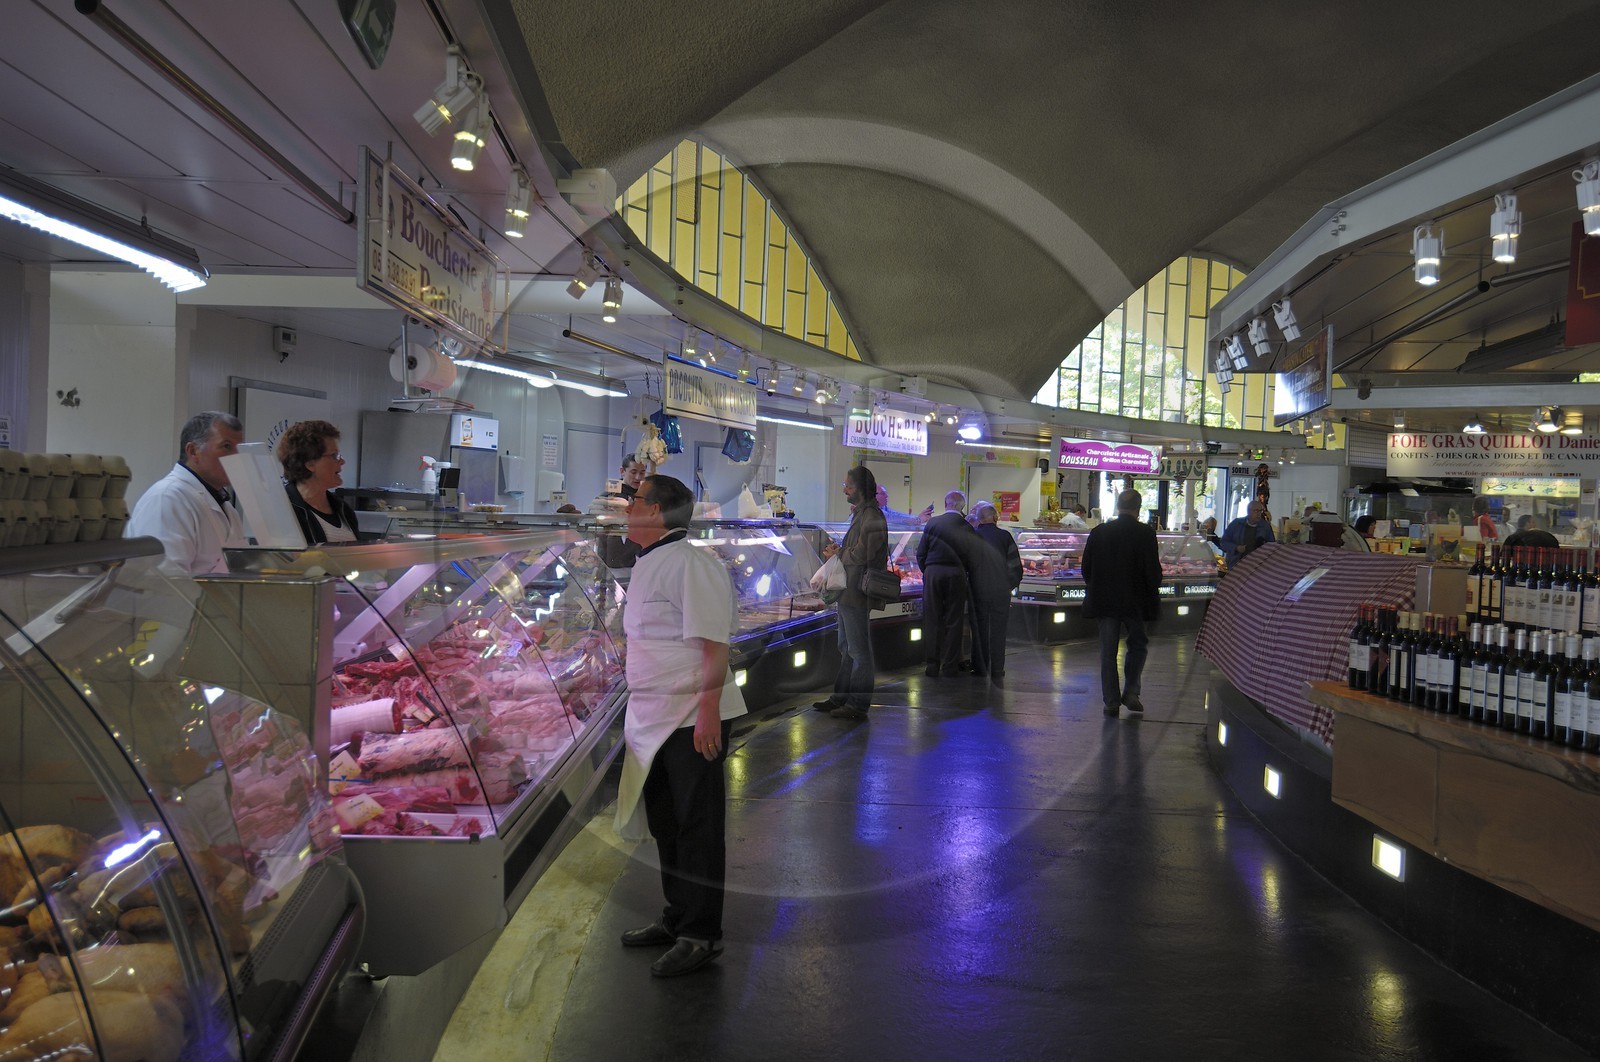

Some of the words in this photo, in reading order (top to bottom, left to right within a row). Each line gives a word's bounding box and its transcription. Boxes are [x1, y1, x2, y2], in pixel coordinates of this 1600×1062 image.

[401, 193, 478, 293] Boucherie
[419, 263, 493, 340] Parisienne
[1391, 434, 1428, 449] FOIE
[1432, 434, 1475, 449] GRAS
[1479, 434, 1554, 452] QUILLOT
[1559, 434, 1600, 449] Danie
[1060, 454, 1099, 466] ROUSSEAU
[1390, 452, 1429, 460] CONFITS
[1436, 452, 1463, 460] FOIES
[1464, 452, 1490, 460] GRAS
[1494, 452, 1525, 460] D'OIES
[1231, 466, 1250, 475] SORTIE
[1445, 470, 1543, 478] www.foie-gras-quillot.com
[1069, 589, 1086, 598] ROUS
